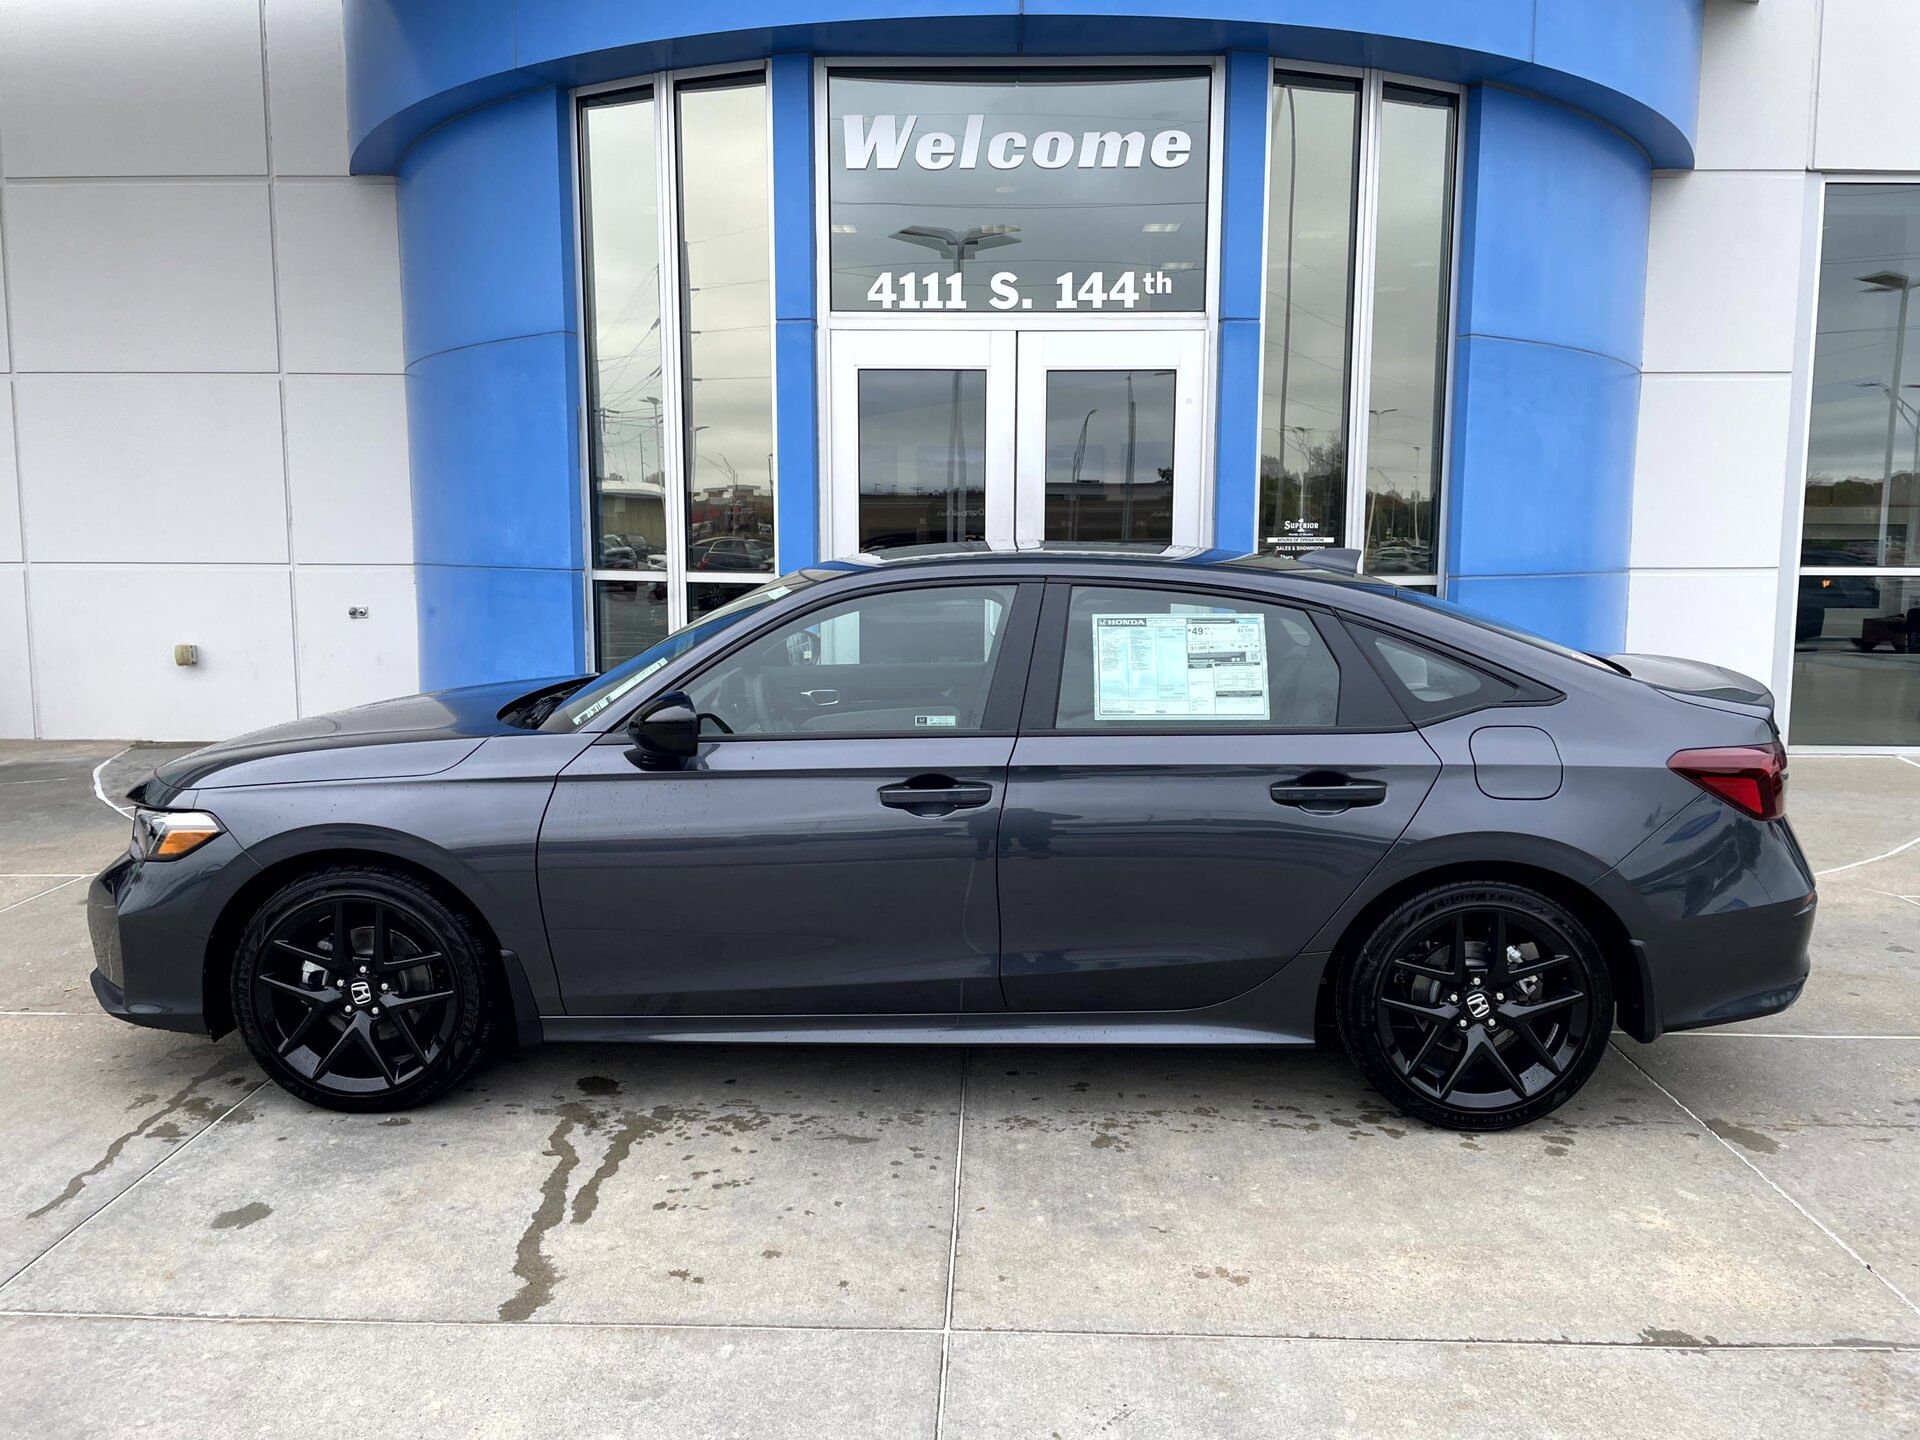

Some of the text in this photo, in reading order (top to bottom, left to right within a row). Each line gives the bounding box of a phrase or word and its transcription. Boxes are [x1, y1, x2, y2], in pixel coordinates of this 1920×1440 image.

[843, 114, 1192, 170] Welcome
[867, 271, 1173, 309] 4111 S. 144th
[1192, 627, 1204, 635] 49
